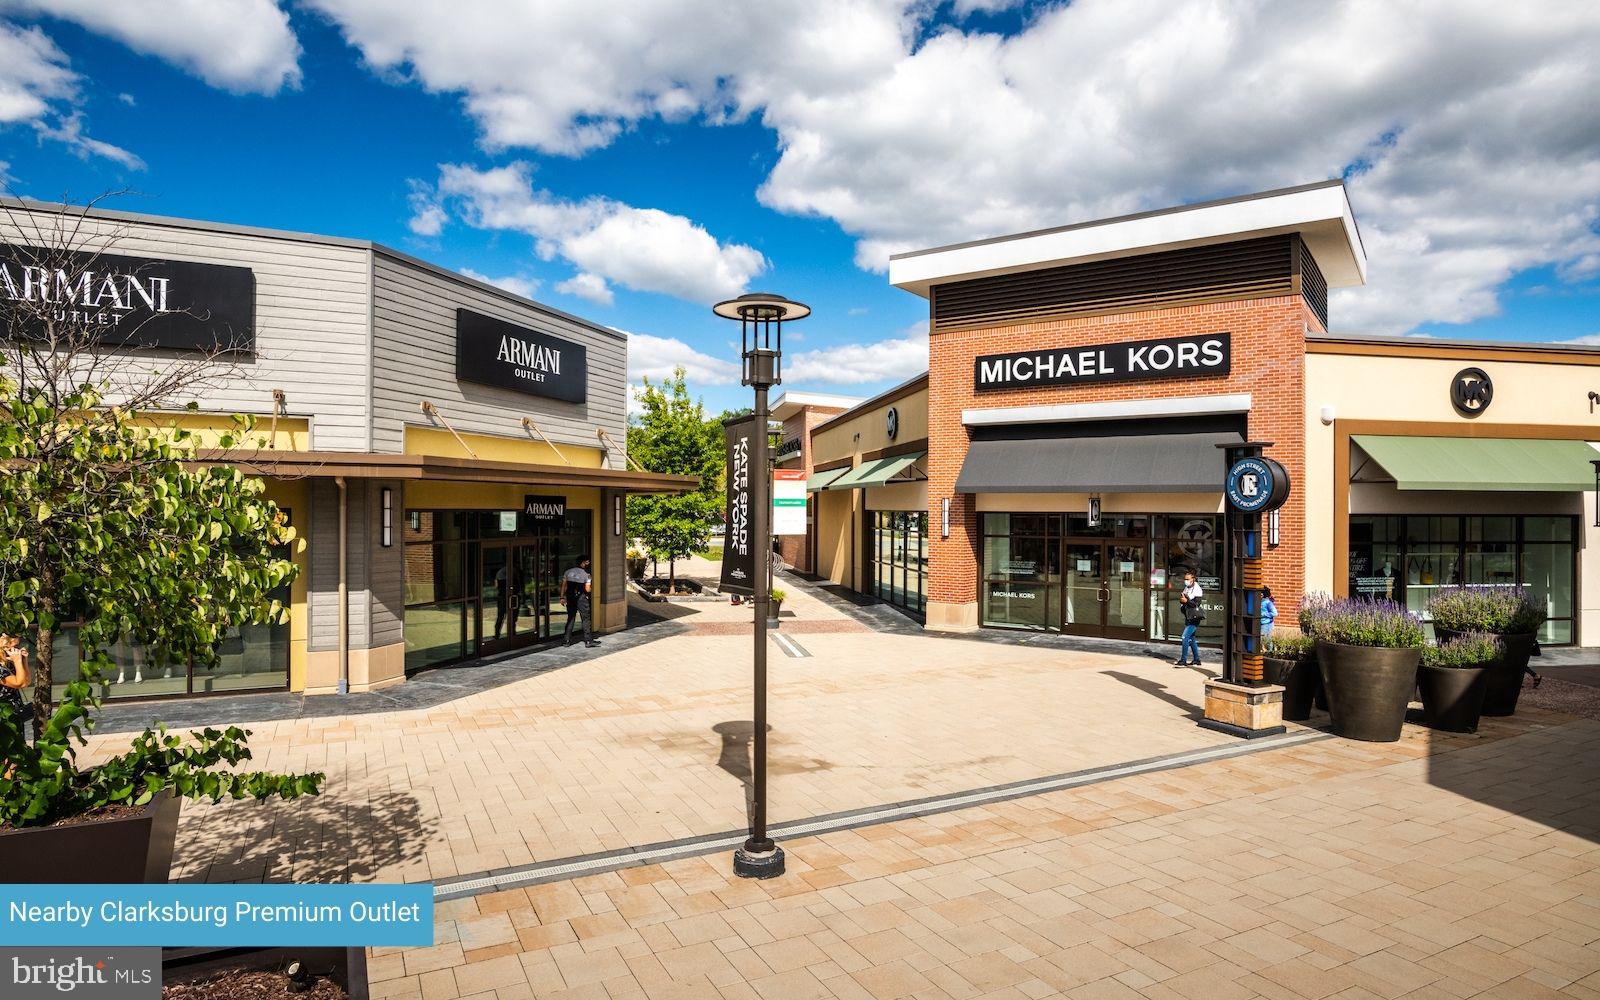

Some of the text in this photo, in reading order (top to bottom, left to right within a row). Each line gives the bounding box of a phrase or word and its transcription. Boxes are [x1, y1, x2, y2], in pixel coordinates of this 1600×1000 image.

[496, 334, 561, 375] ARMANI
[980, 339, 1224, 384] MICHAEL KORS
[514, 368, 545, 382] OUTLET
[1233, 462, 1266, 476] HIGH STREET
[526, 503, 564, 516] ARMANI
[731, 444, 741, 550] NEW YORK
[739, 436, 748, 556] KATE SPADE
[1230, 490, 1268, 508] EAST PROMENADE
